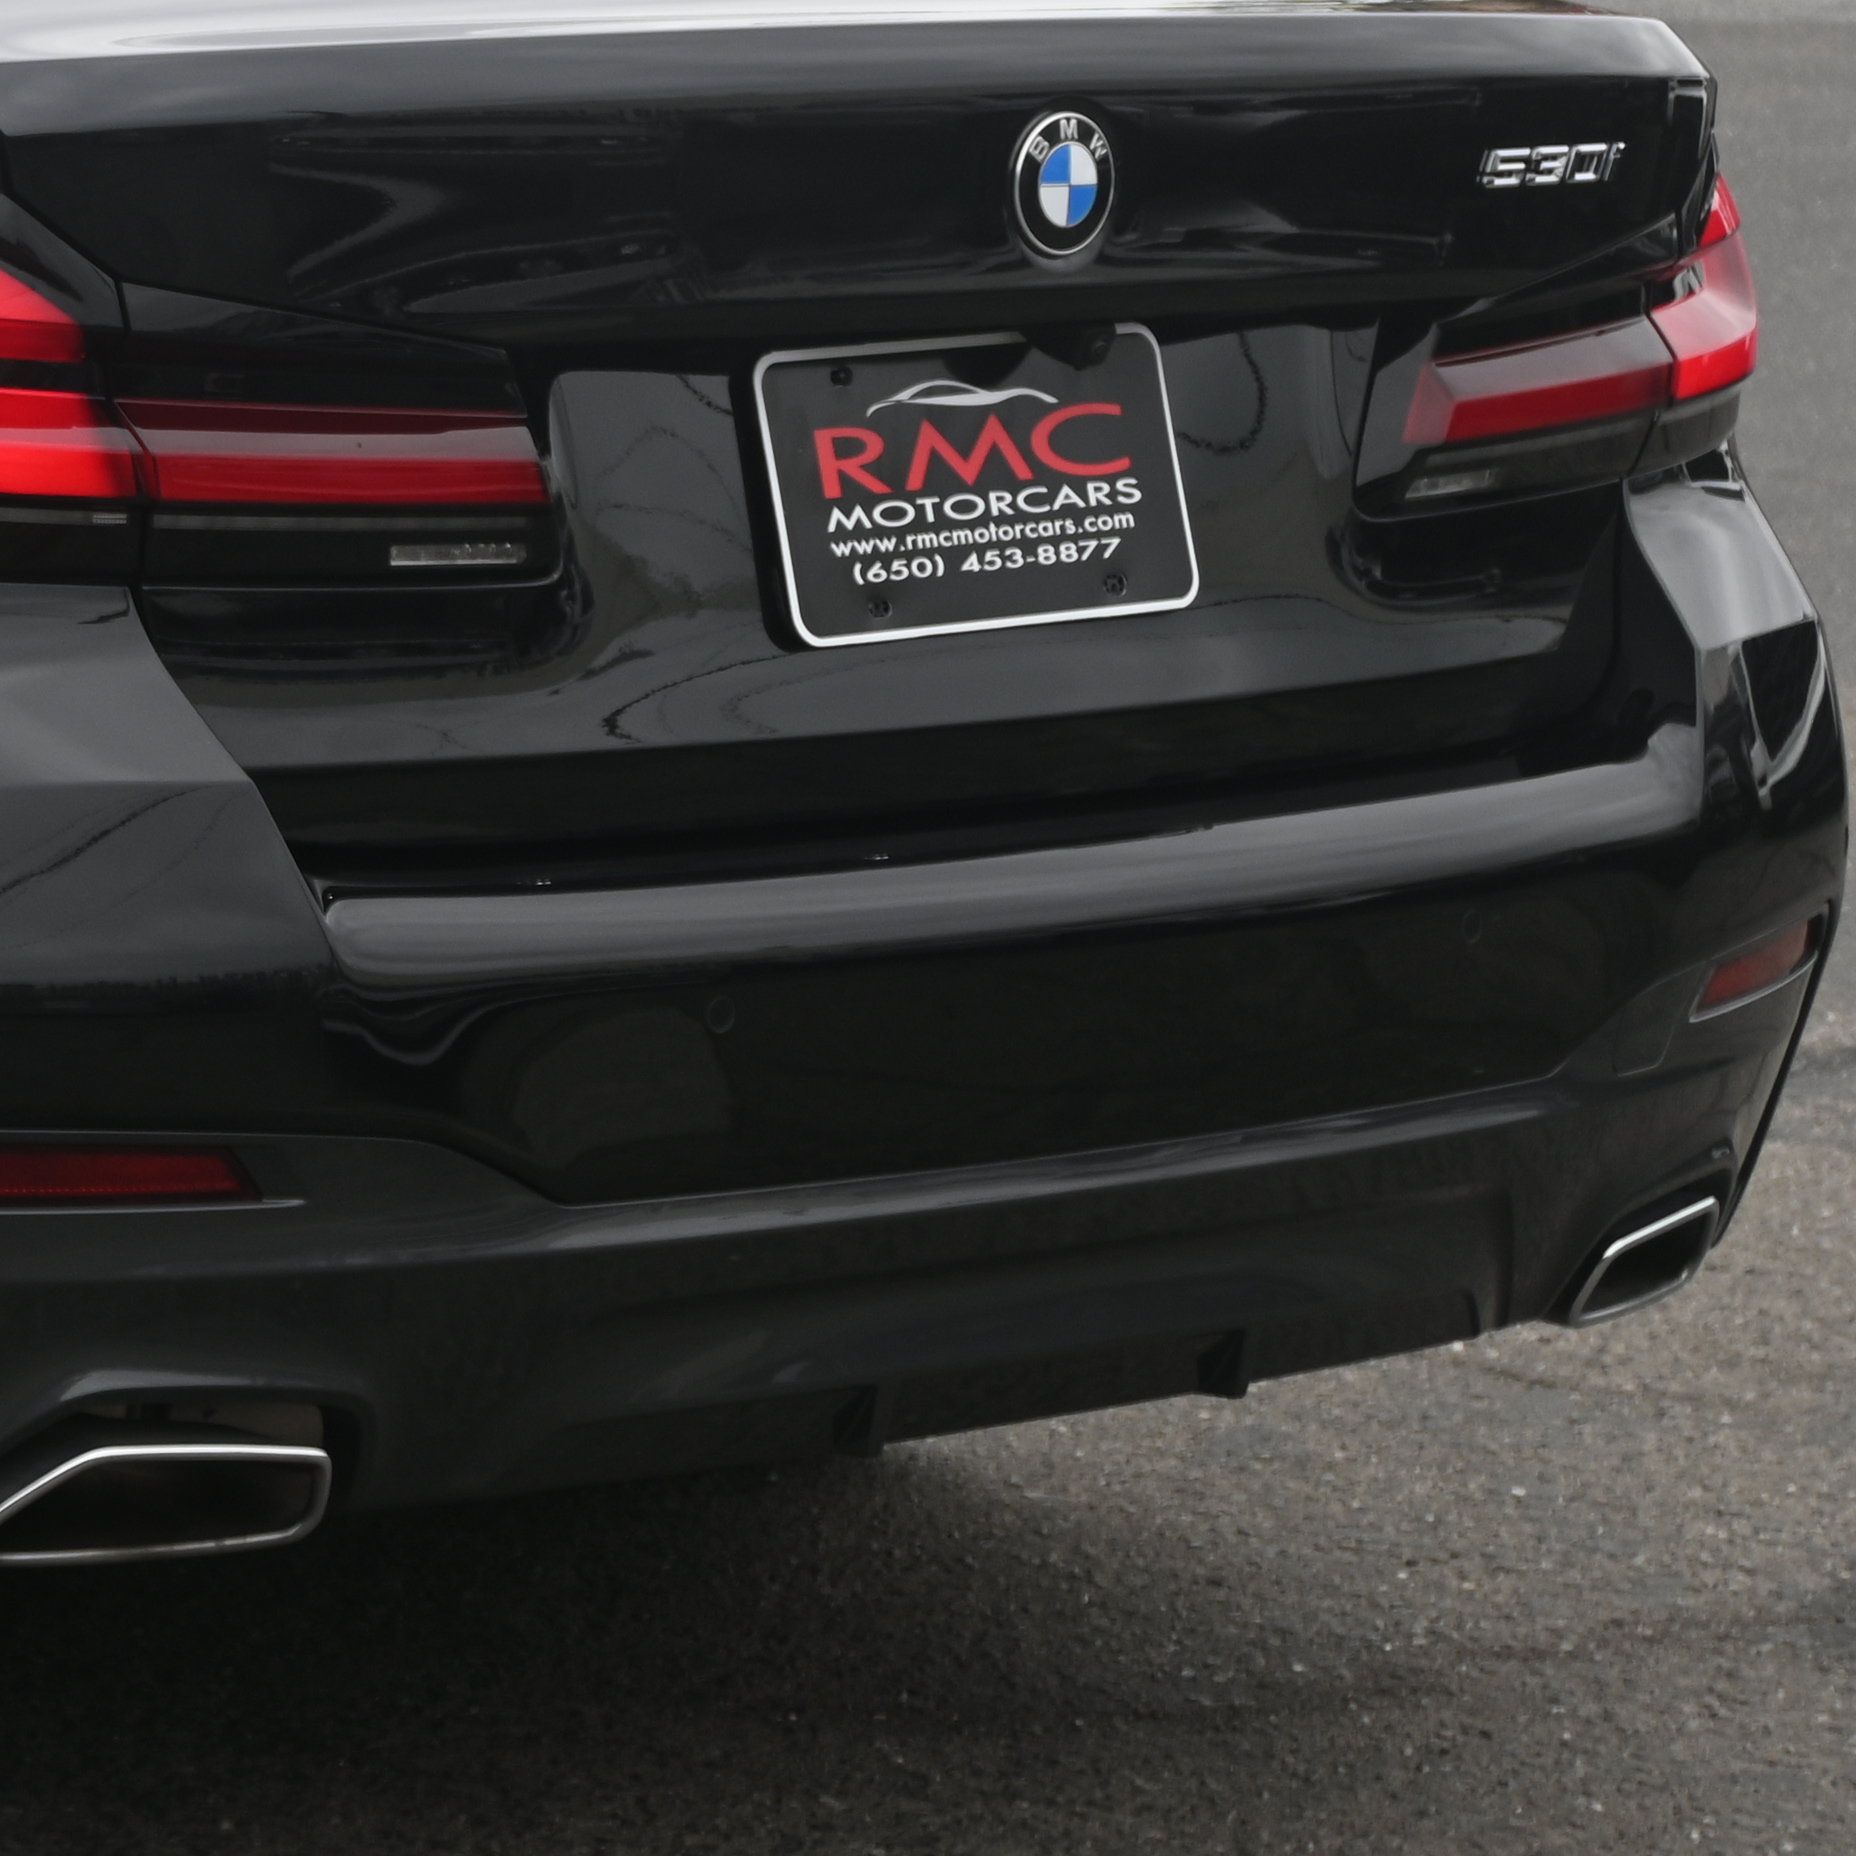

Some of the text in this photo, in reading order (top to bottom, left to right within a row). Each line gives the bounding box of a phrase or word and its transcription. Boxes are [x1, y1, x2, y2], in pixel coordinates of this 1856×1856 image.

[1028, 117, 1108, 164] BMW
[1483, 141, 1626, 189] 530i
[813, 402, 1132, 500] RMC
[827, 477, 1143, 533] MOTORCARS
[829, 511, 1136, 558] www.rmcmotorcars.com
[852, 536, 1122, 585] (650) 453-8877
